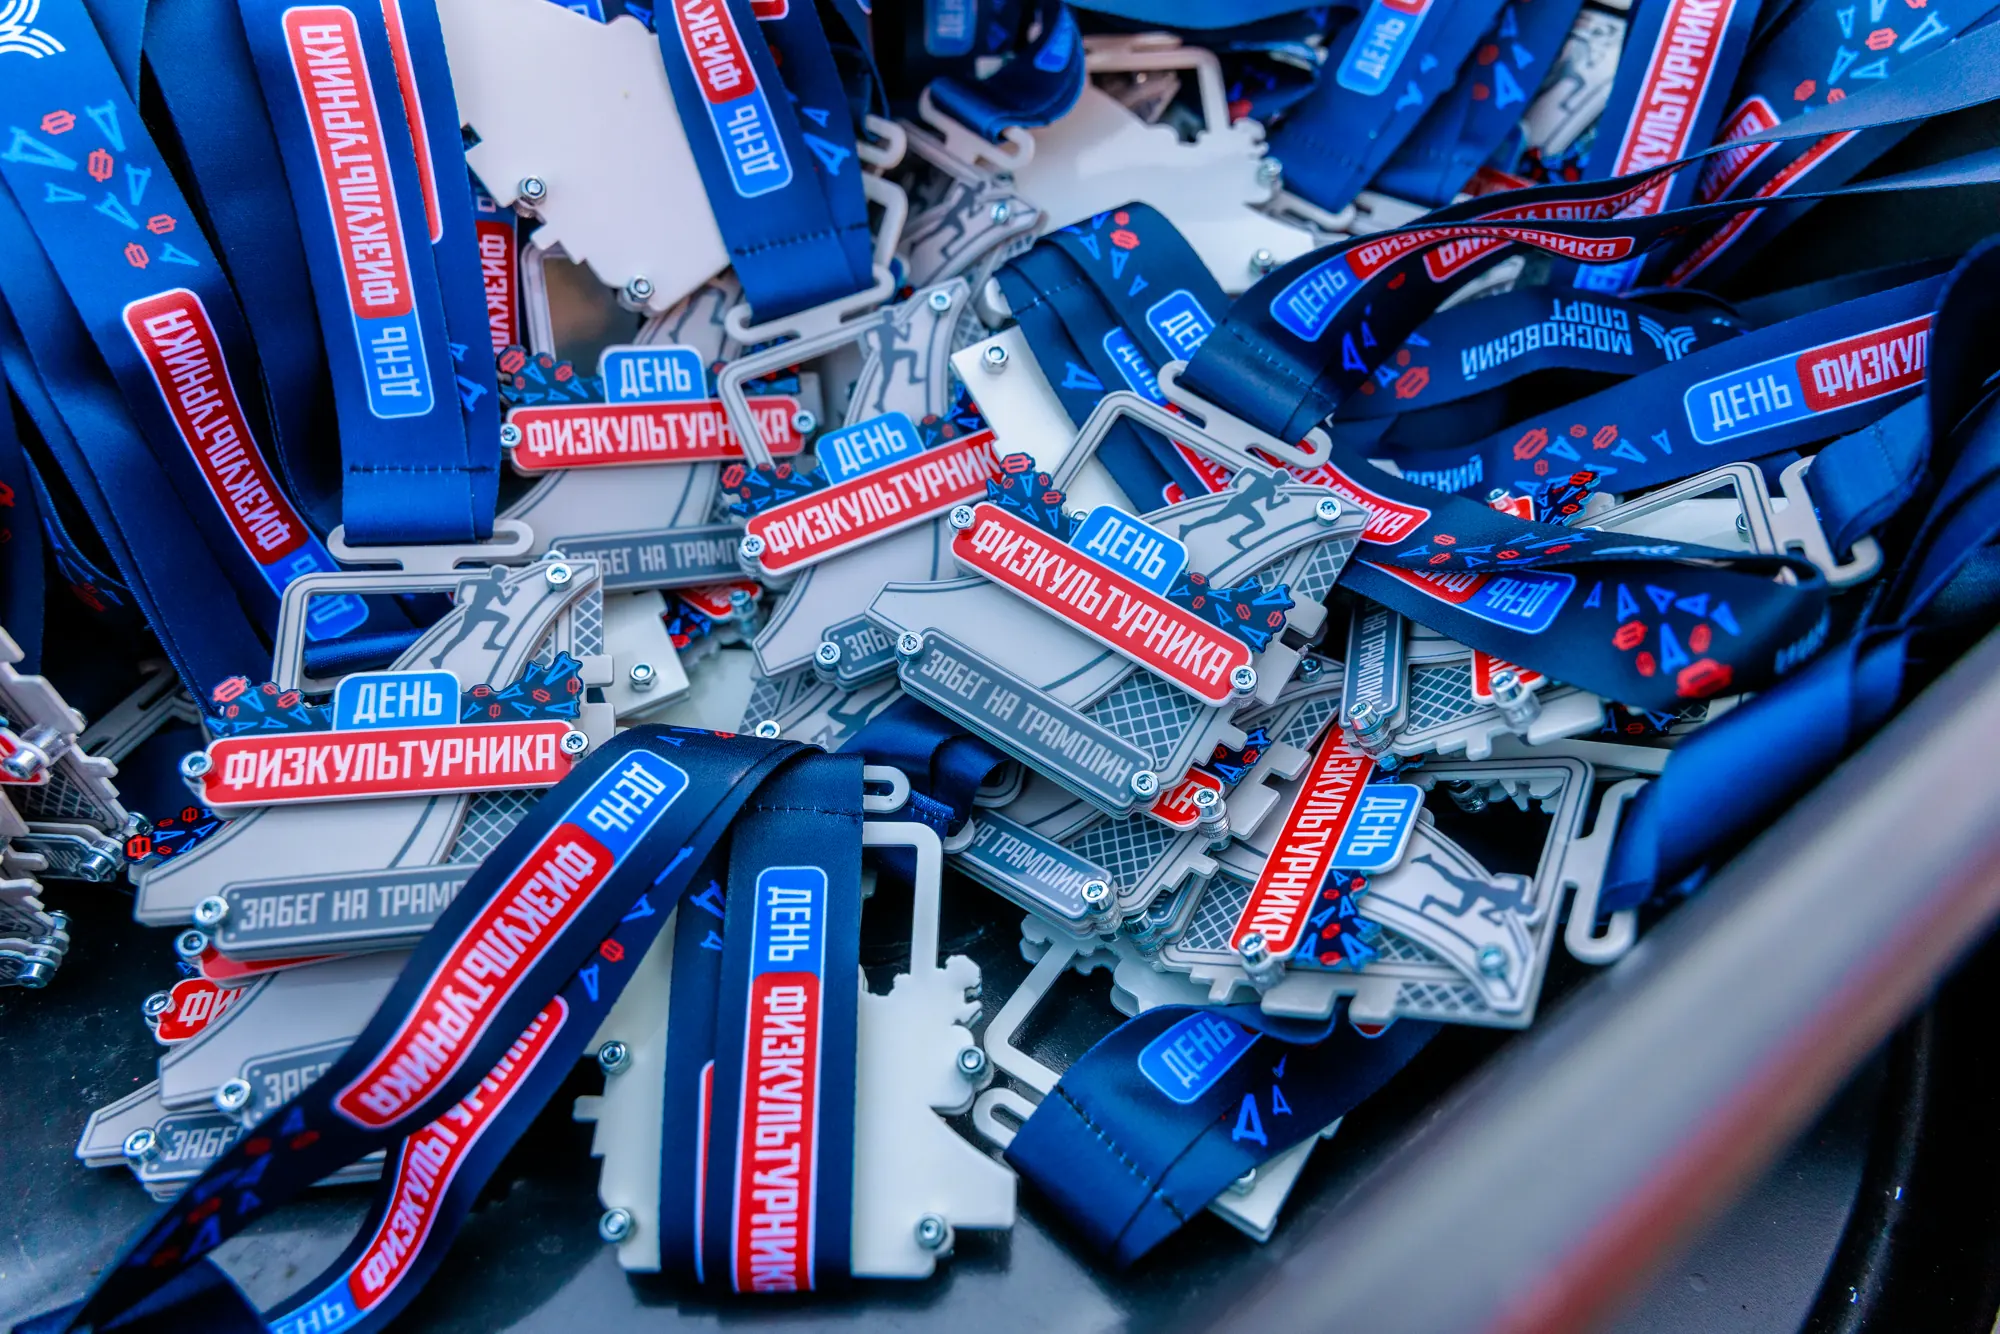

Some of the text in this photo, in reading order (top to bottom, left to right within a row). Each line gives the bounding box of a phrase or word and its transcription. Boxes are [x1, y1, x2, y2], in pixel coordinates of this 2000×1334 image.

[1356, 17, 1406, 80] ДЕНЬ
[727, 104, 779, 177] ДЕНЬ
[300, 23, 422, 398] ДЕНЬ ФИЗКУЛЬТУРНИКА
[1287, 267, 1348, 329] ДЕНЬ
[1550, 297, 1629, 330] СПОРТ
[620, 358, 691, 397] ДЕНЬ
[1461, 322, 1634, 380] МОСКОВСКИЙ
[143, 308, 292, 551] ФИЗКУЛЬТУРНИКА
[526, 408, 790, 458] ФИЗКУЛЬТУРНКА
[1711, 374, 1793, 432] ДЕНЬ
[833, 422, 907, 476] ДЕНЬ
[638, 545, 667, 572] НА
[1086, 516, 1168, 580] ДЕНЬ
[970, 518, 1234, 687] ФИЗКУЛЬТУРНИКА
[1486, 577, 1558, 618] ДЕНЬ
[352, 680, 443, 724] ДЕНЬ
[920, 649, 1135, 789] ЗАБЕГ НА ТРАМПЛИН
[223, 733, 556, 790] ФИЗКУЛЬТУРНИКА
[1249, 736, 1362, 941] ИЗКУЛЬТУРНИКА
[1347, 796, 1408, 856] ДЕНЬ
[239, 892, 325, 931] ЗАБЕГ
[332, 889, 369, 921] НА
[358, 761, 667, 1117] ДЕНЬ ФИЗКУЛЬТУРНИКА
[768, 887, 811, 961] ДЕНЬ
[1161, 1017, 1237, 1088] ДЕНЬ
